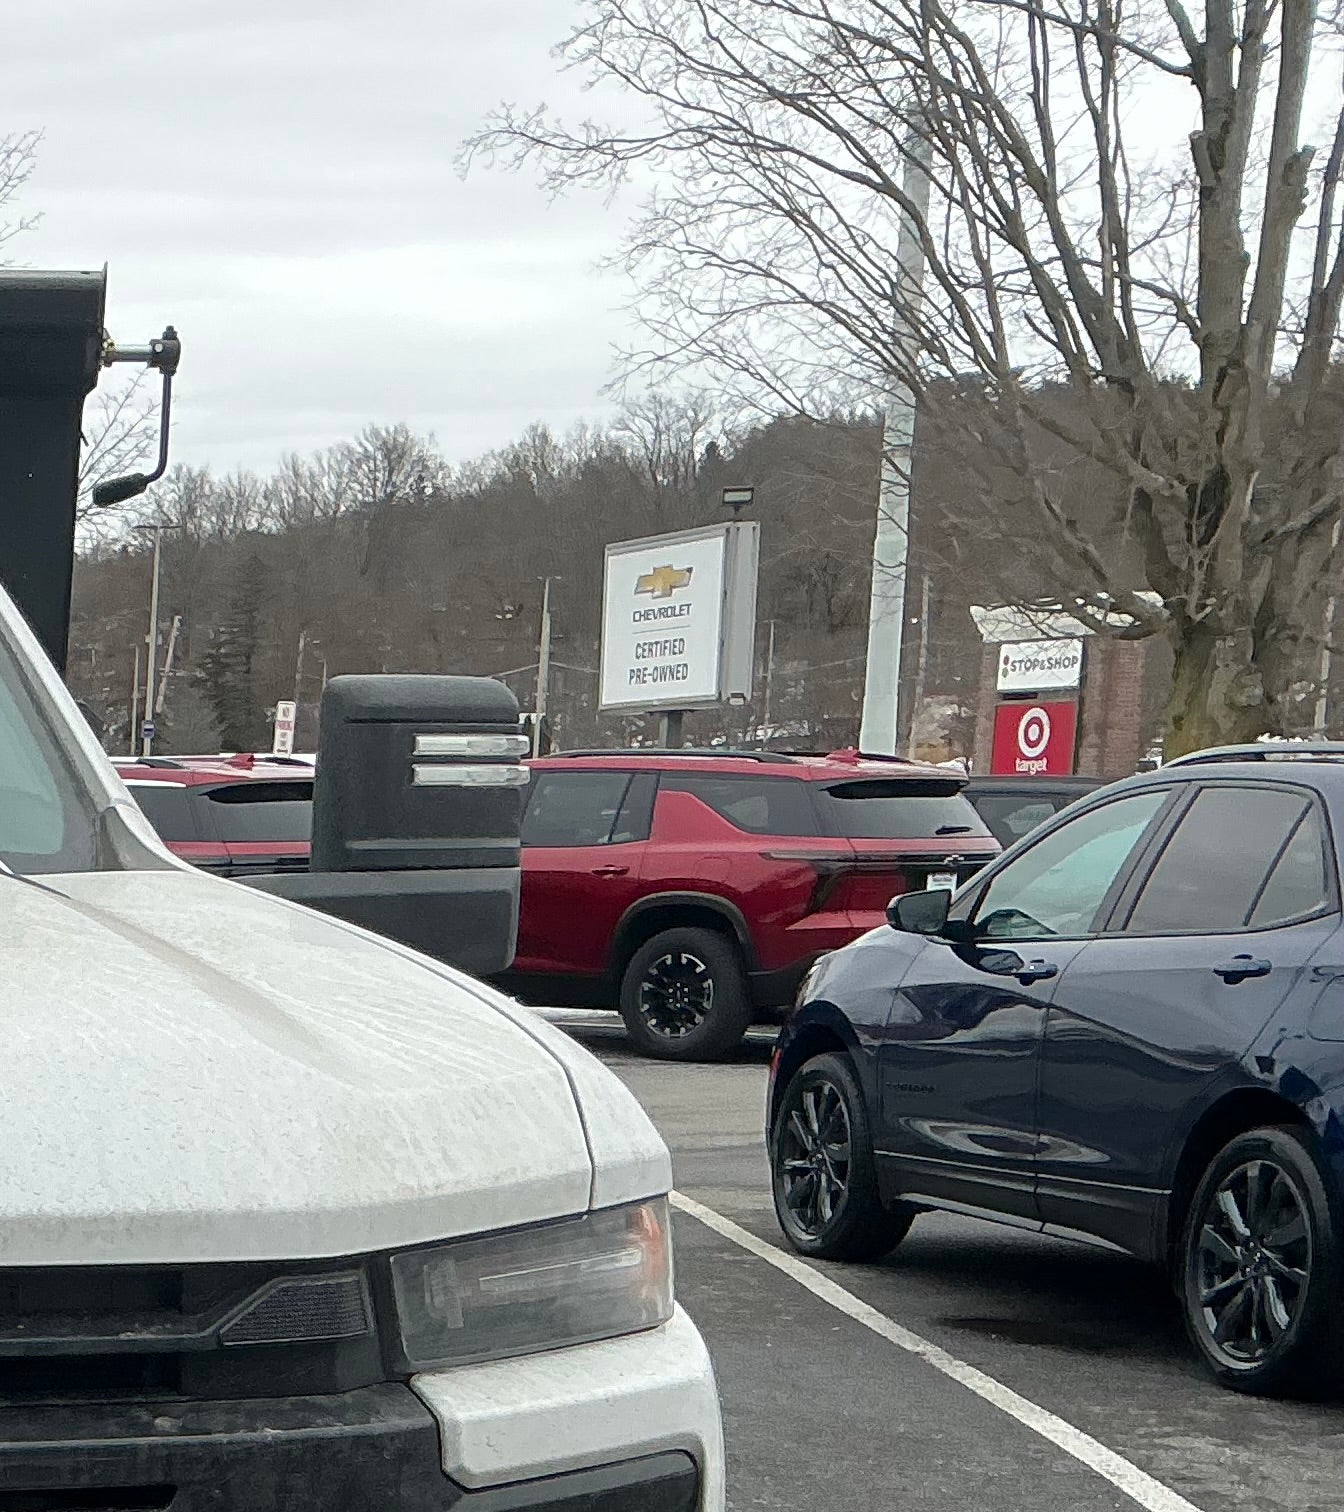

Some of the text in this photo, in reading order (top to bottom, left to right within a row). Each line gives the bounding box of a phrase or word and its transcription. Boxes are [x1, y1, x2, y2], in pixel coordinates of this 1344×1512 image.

[632, 603, 692, 622] CHEVROLET
[635, 638, 685, 660] CERTIFIED
[628, 663, 689, 685] PRE-OWNED
[1015, 757, 1048, 775] target
